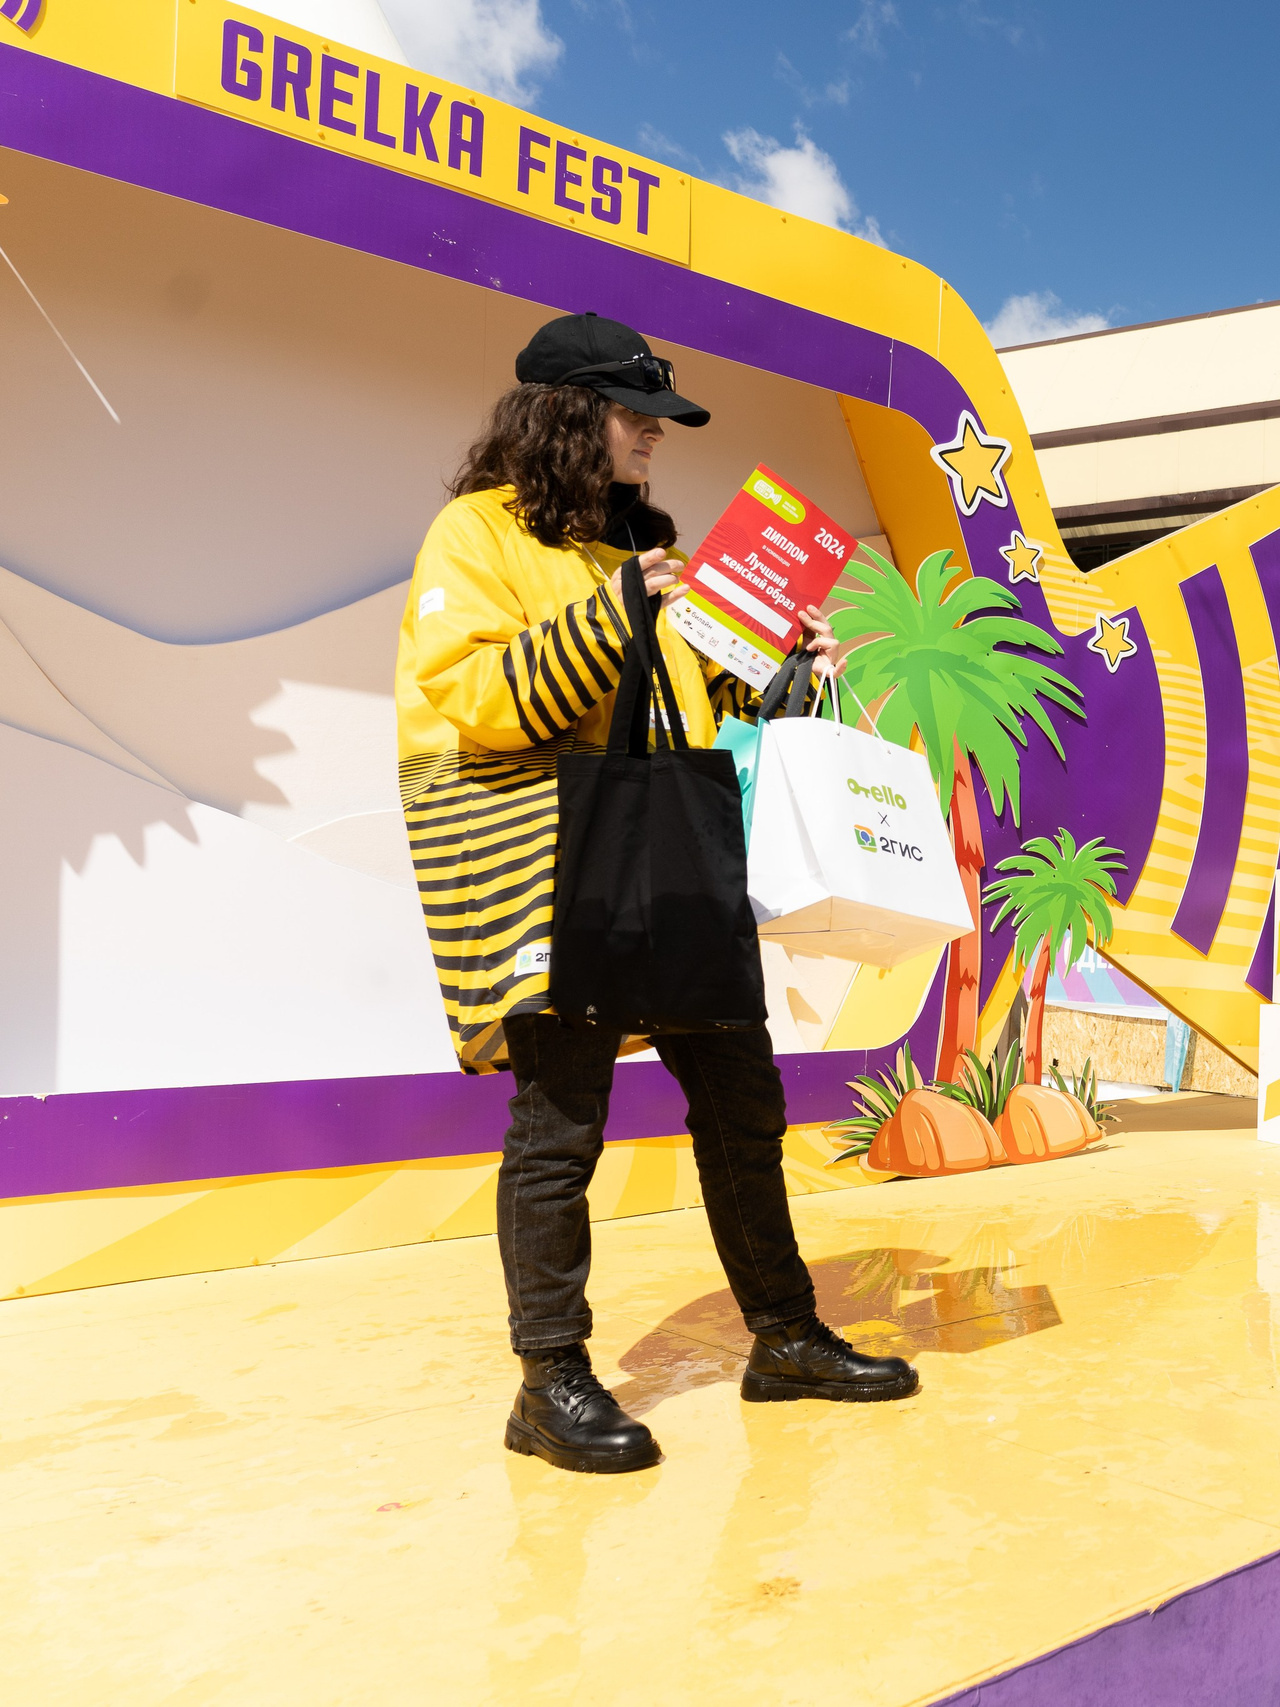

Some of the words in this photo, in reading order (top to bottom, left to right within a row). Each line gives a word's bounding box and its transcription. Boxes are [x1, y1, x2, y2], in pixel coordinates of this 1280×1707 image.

[221, 19, 484, 177] GRELKA
[517, 126, 660, 235] FEST
[761, 526, 809, 565] ДИПЛОМ
[814, 527, 846, 560] 2024
[719, 553, 768, 590] женский
[765, 586, 796, 611] образ
[744, 552, 789, 589] Лучший
[691, 611, 713, 630] билайн
[879, 836, 923, 862] 2ГИС
